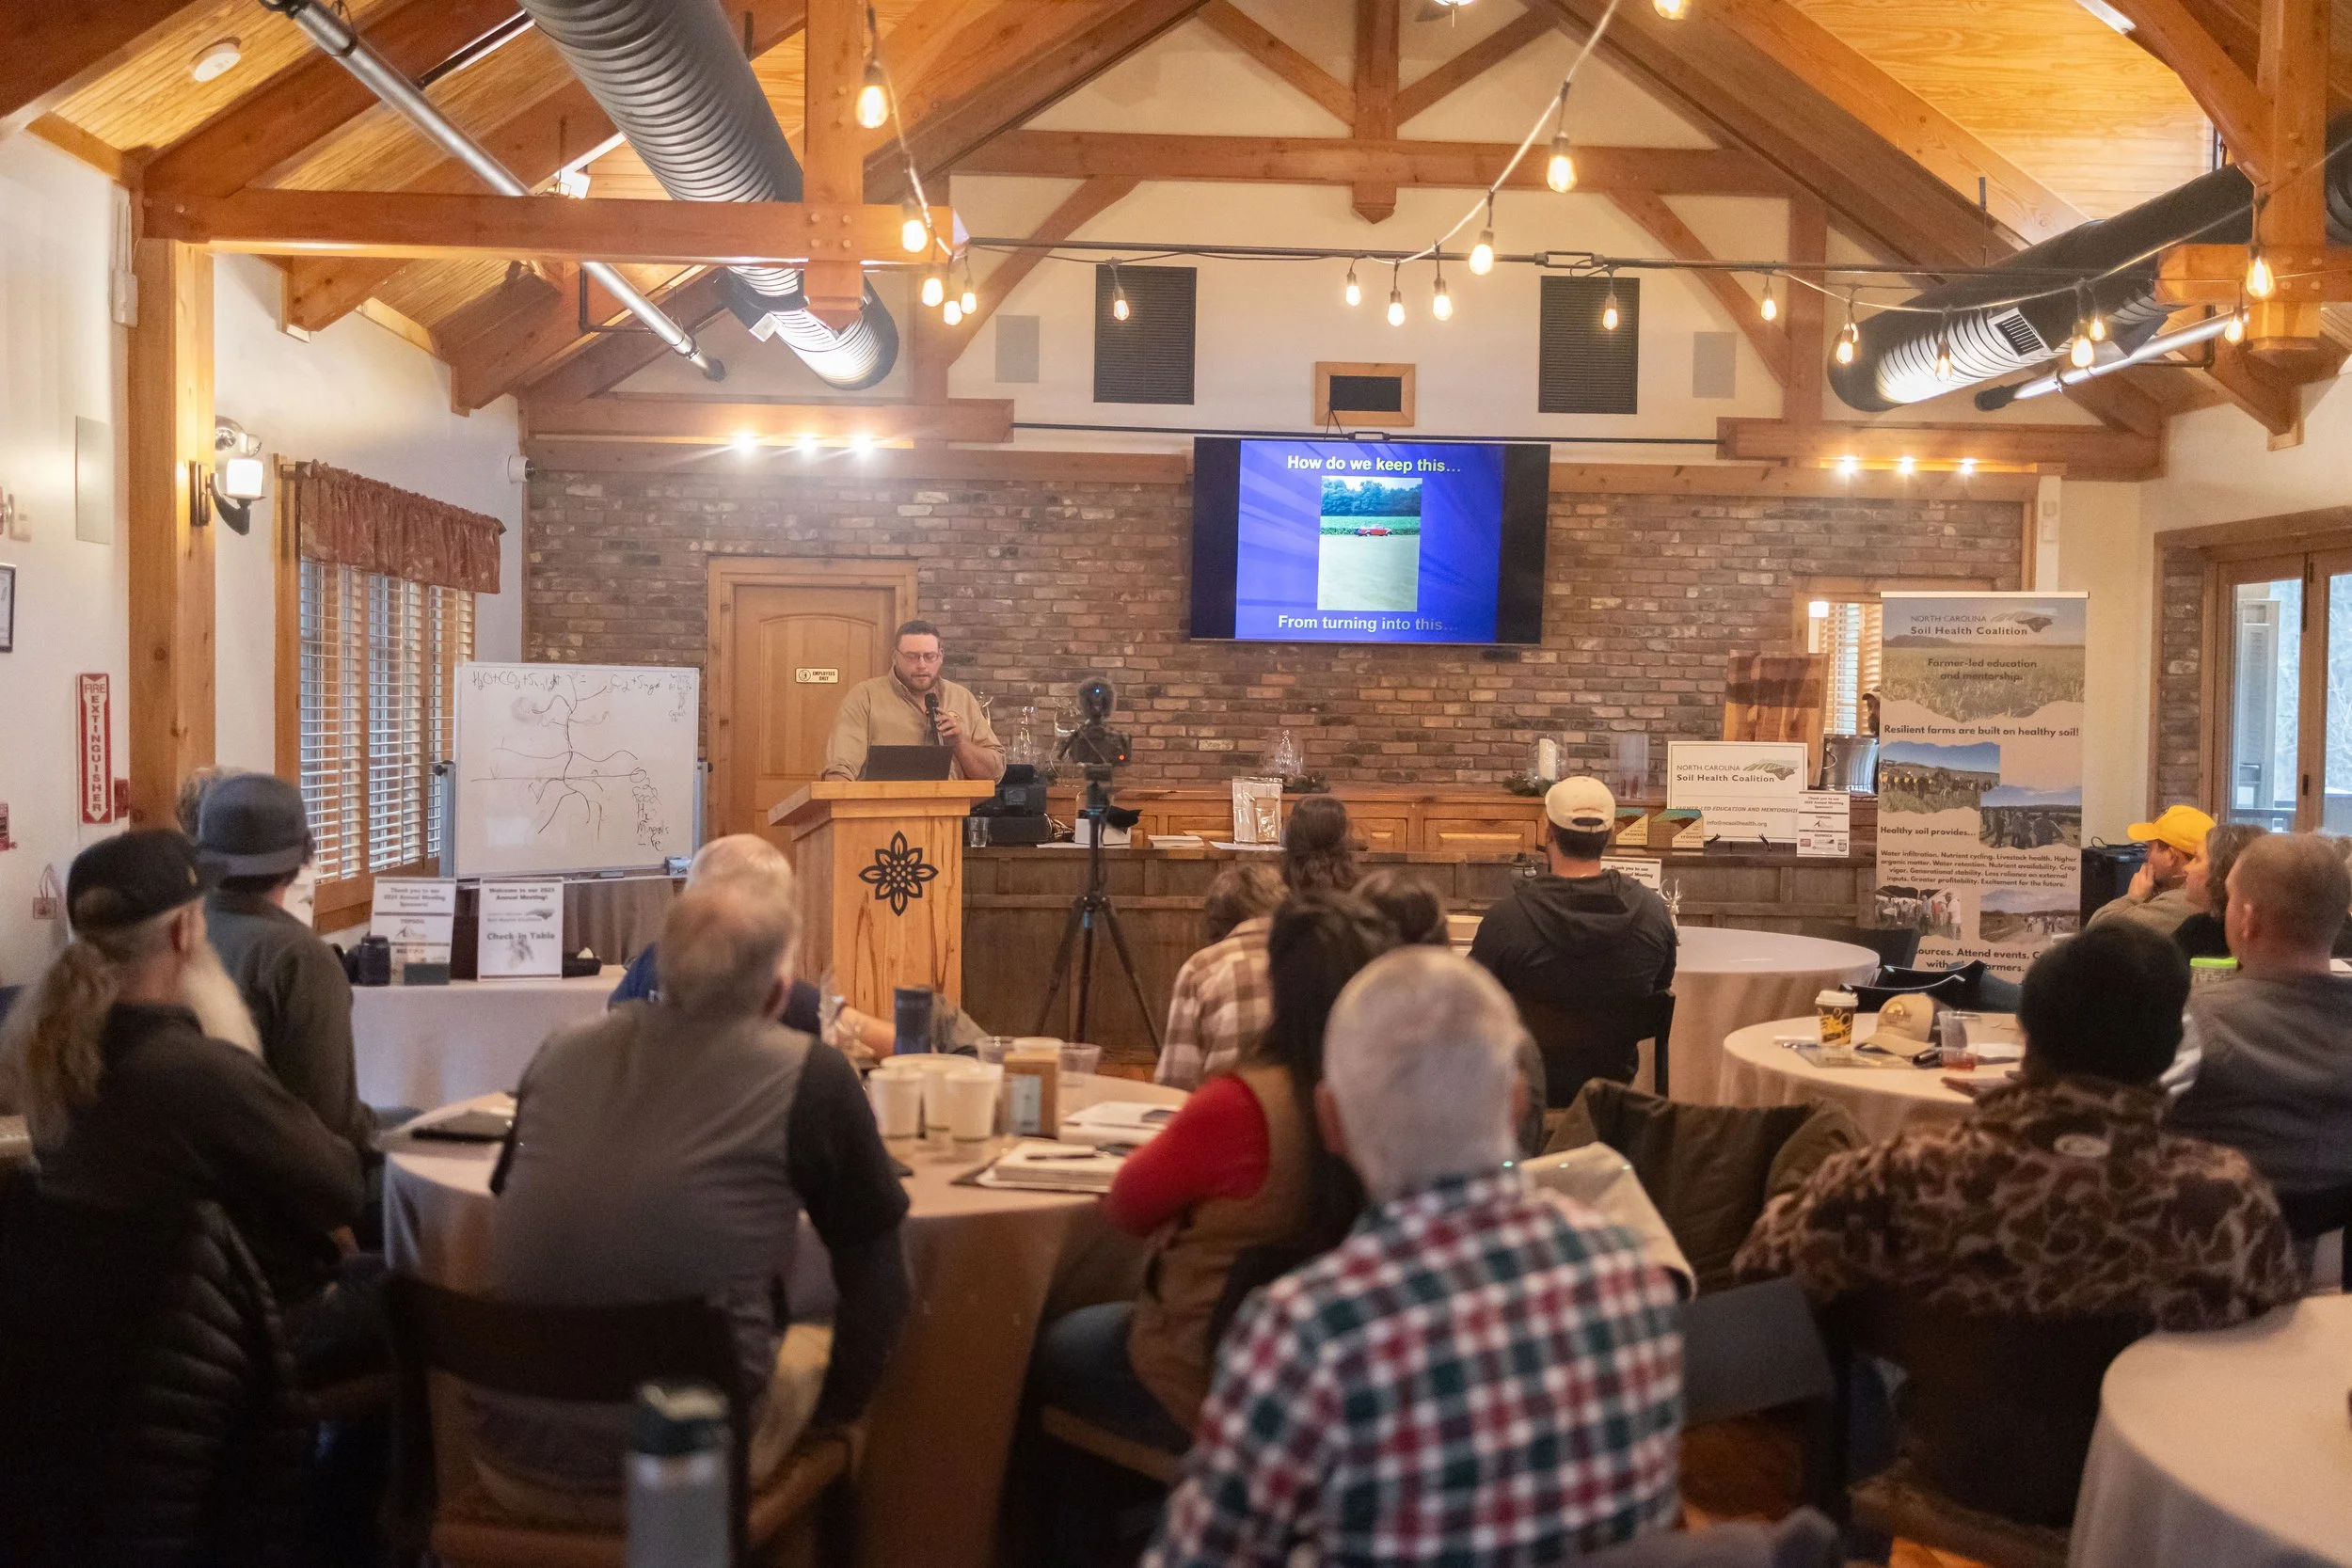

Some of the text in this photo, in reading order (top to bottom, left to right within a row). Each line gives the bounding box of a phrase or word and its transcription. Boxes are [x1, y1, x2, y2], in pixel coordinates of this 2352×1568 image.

[1287, 455, 1322, 469] How
[1326, 456, 1346, 470] do
[1350, 459, 1372, 470] we
[1376, 457, 1413, 474] keep
[1278, 614, 1318, 629] From
[1322, 616, 1377, 633] turning
[1382, 617, 1410, 630] into
[1911, 626, 2027, 636] Soil Health Coalition
[1928, 658, 2037, 668] Farmer-led education
[1940, 672, 2024, 682] and mentorship.
[84, 684, 105, 693] FIRE
[1884, 725, 1925, 734] Resilient
[1927, 725, 1956, 735] farms
[1978, 726, 2000, 735] built
[2018, 727, 2056, 738] healthy
[2058, 727, 2079, 736] soil!
[91, 695, 102, 812] EXTINGUISHER
[1732, 774, 1774, 783] Coalition
[1881, 827, 1976, 836] Healthy soil provides...
[1957, 948, 1992, 958] Attend
[1994, 951, 2029, 959] events.
[1926, 959, 2025, 973] with armers.
